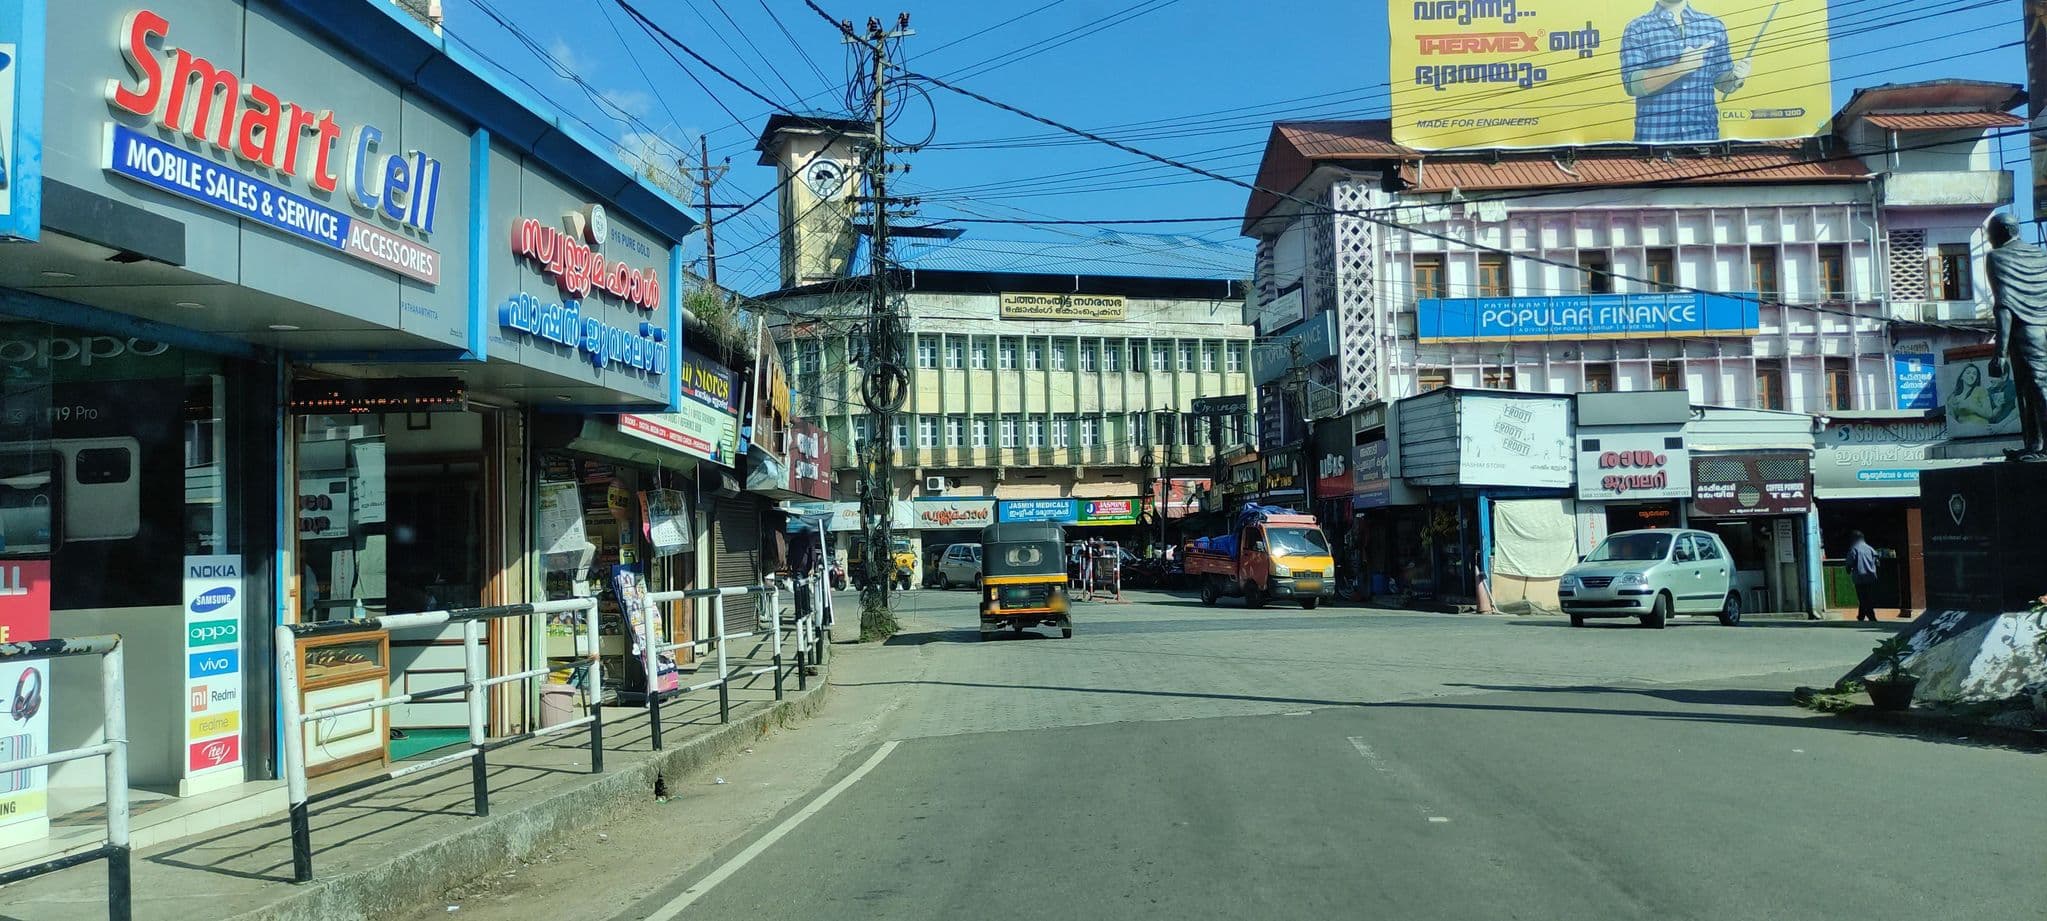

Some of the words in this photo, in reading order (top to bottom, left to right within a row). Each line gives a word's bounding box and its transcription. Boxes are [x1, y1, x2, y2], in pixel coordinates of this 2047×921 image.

[1722, 110, 1746, 119] CALL
[105, 9, 342, 192] Smart
[346, 124, 440, 235] Cell
[1417, 119, 1449, 128] MADE
[1451, 118, 1475, 127] FOR
[1476, 117, 1539, 127] ENGINEERS
[126, 139, 202, 193] MOBILE
[205, 167, 258, 212] SALES
[260, 190, 274, 218] &
[351, 226, 434, 276] ACCESSORIES
[1005, 294, 1072, 308] പത്തനംതിട്ട
[1074, 297, 1122, 307] നഗരസഭ
[1482, 307, 1593, 328] POPULAR
[1600, 305, 1696, 325] FINANCE
[695, 358, 729, 400] Stores
[76, 405, 98, 421] Pro
[1009, 501, 1034, 510] JASMIN
[1035, 501, 1069, 509] MEDICALS
[190, 565, 237, 578] NOKIA
[196, 594, 232, 606] SAMSUNG
[190, 625, 236, 639] oppo
[199, 657, 229, 672] vivo
[211, 688, 237, 702] Redmi
[199, 715, 230, 732] realme
[207, 743, 225, 760] itel
